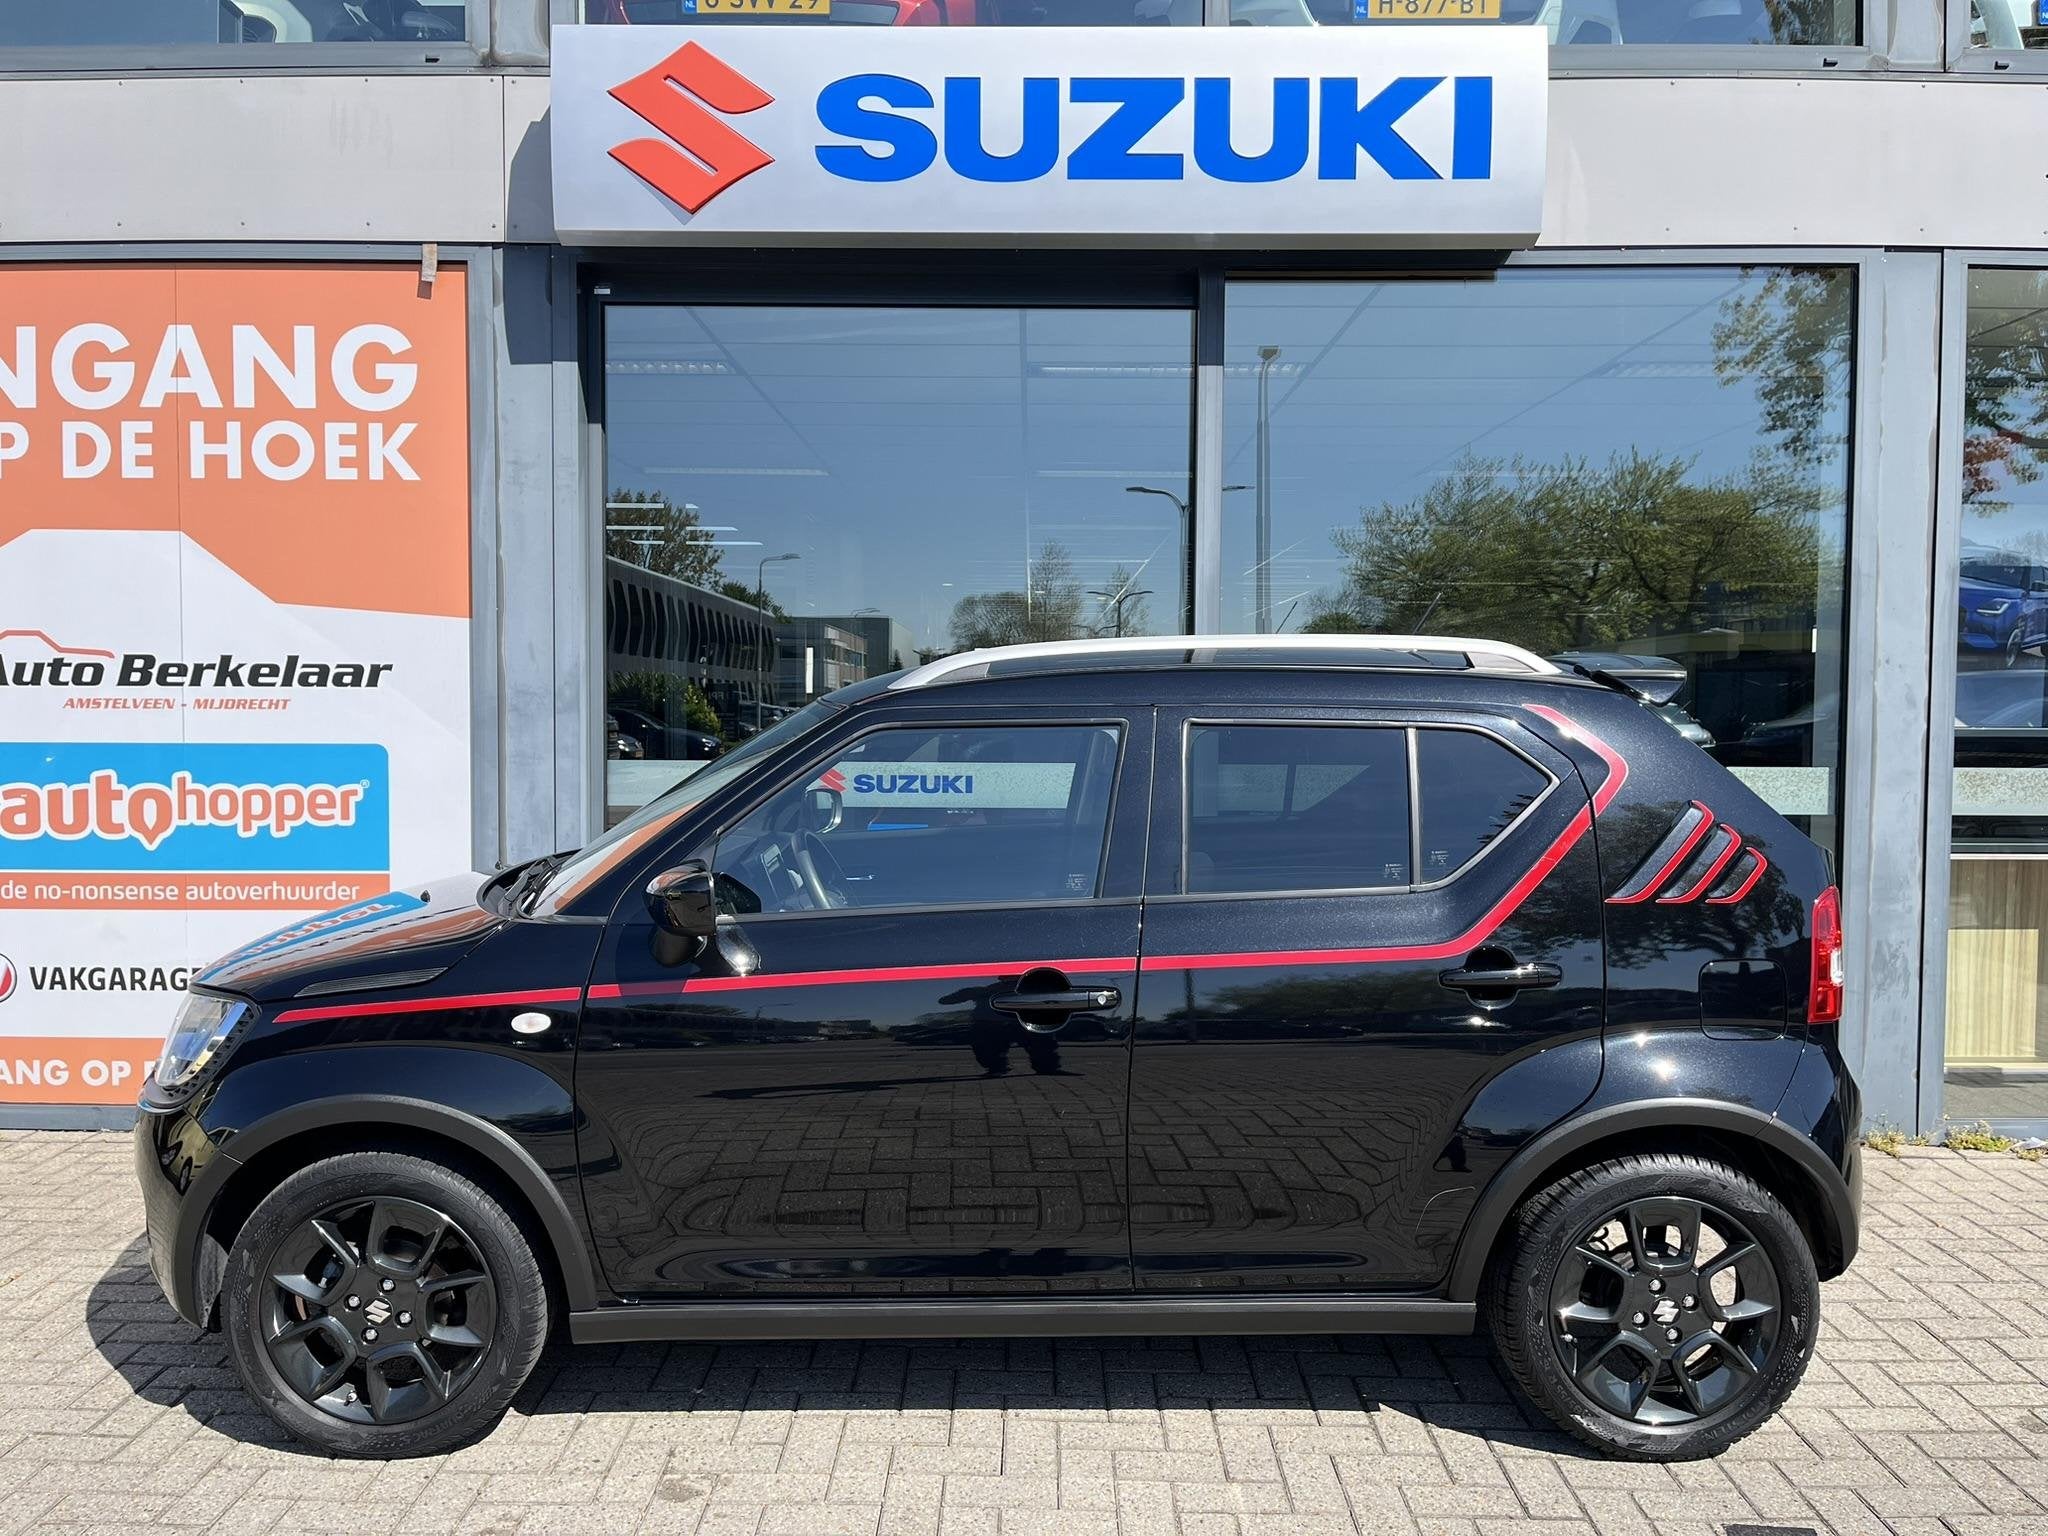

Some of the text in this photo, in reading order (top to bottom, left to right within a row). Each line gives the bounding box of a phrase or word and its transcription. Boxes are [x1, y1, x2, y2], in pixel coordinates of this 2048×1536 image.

[814, 74, 1493, 182] SUZUKI
[62, 421, 154, 479] DE
[190, 420, 421, 481] HOEK
[0, 653, 393, 688] uto Berkelaar
[63, 698, 175, 710] AMSTELVEEN
[193, 698, 291, 711] MIJDRECHT
[853, 773, 974, 794] SUZUKI
[1, 879, 360, 901] de no-nonsense autoverhuurder
[81, 1059, 132, 1087] OP
